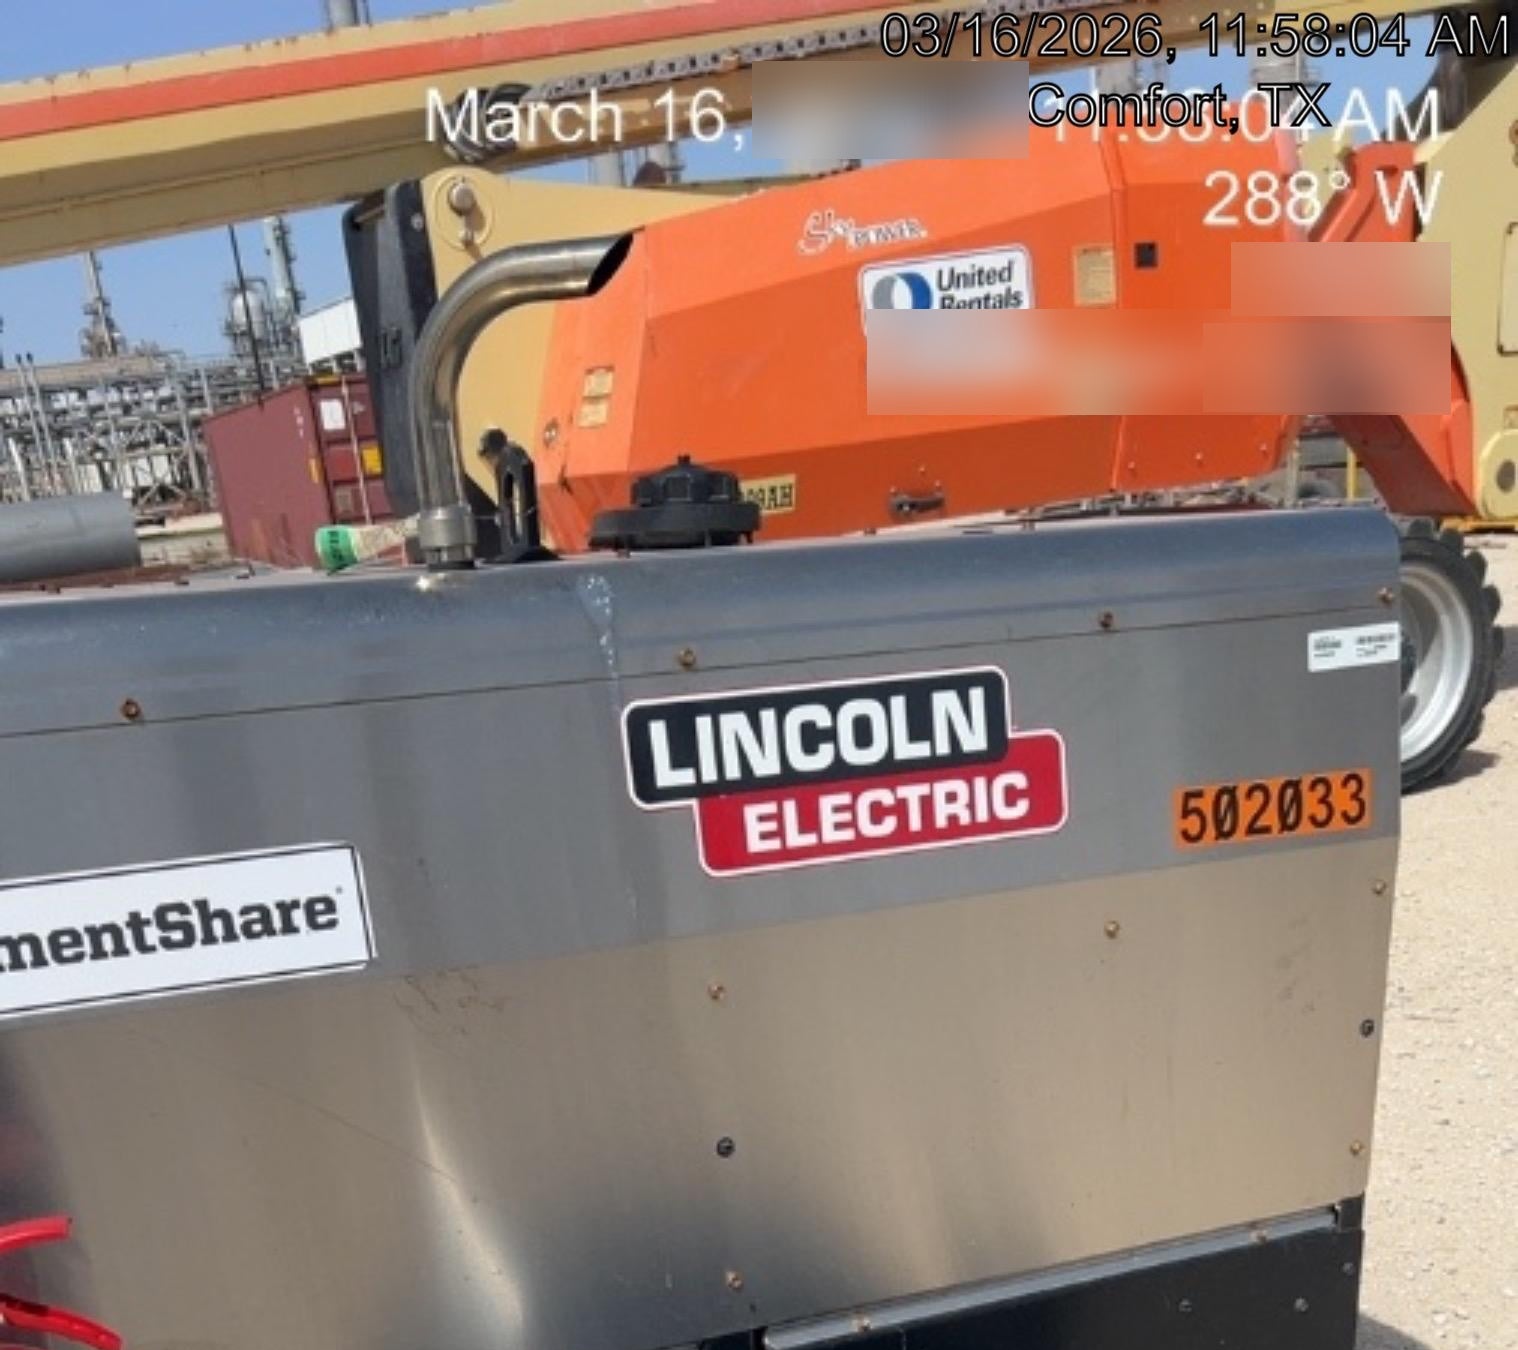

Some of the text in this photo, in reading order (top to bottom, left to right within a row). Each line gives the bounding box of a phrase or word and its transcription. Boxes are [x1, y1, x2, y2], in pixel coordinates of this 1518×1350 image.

[936, 259, 1015, 292] United
[648, 686, 989, 789] LINCOLN
[742, 772, 1030, 853] ELECTRIC
[1180, 773, 1366, 843] 502033
